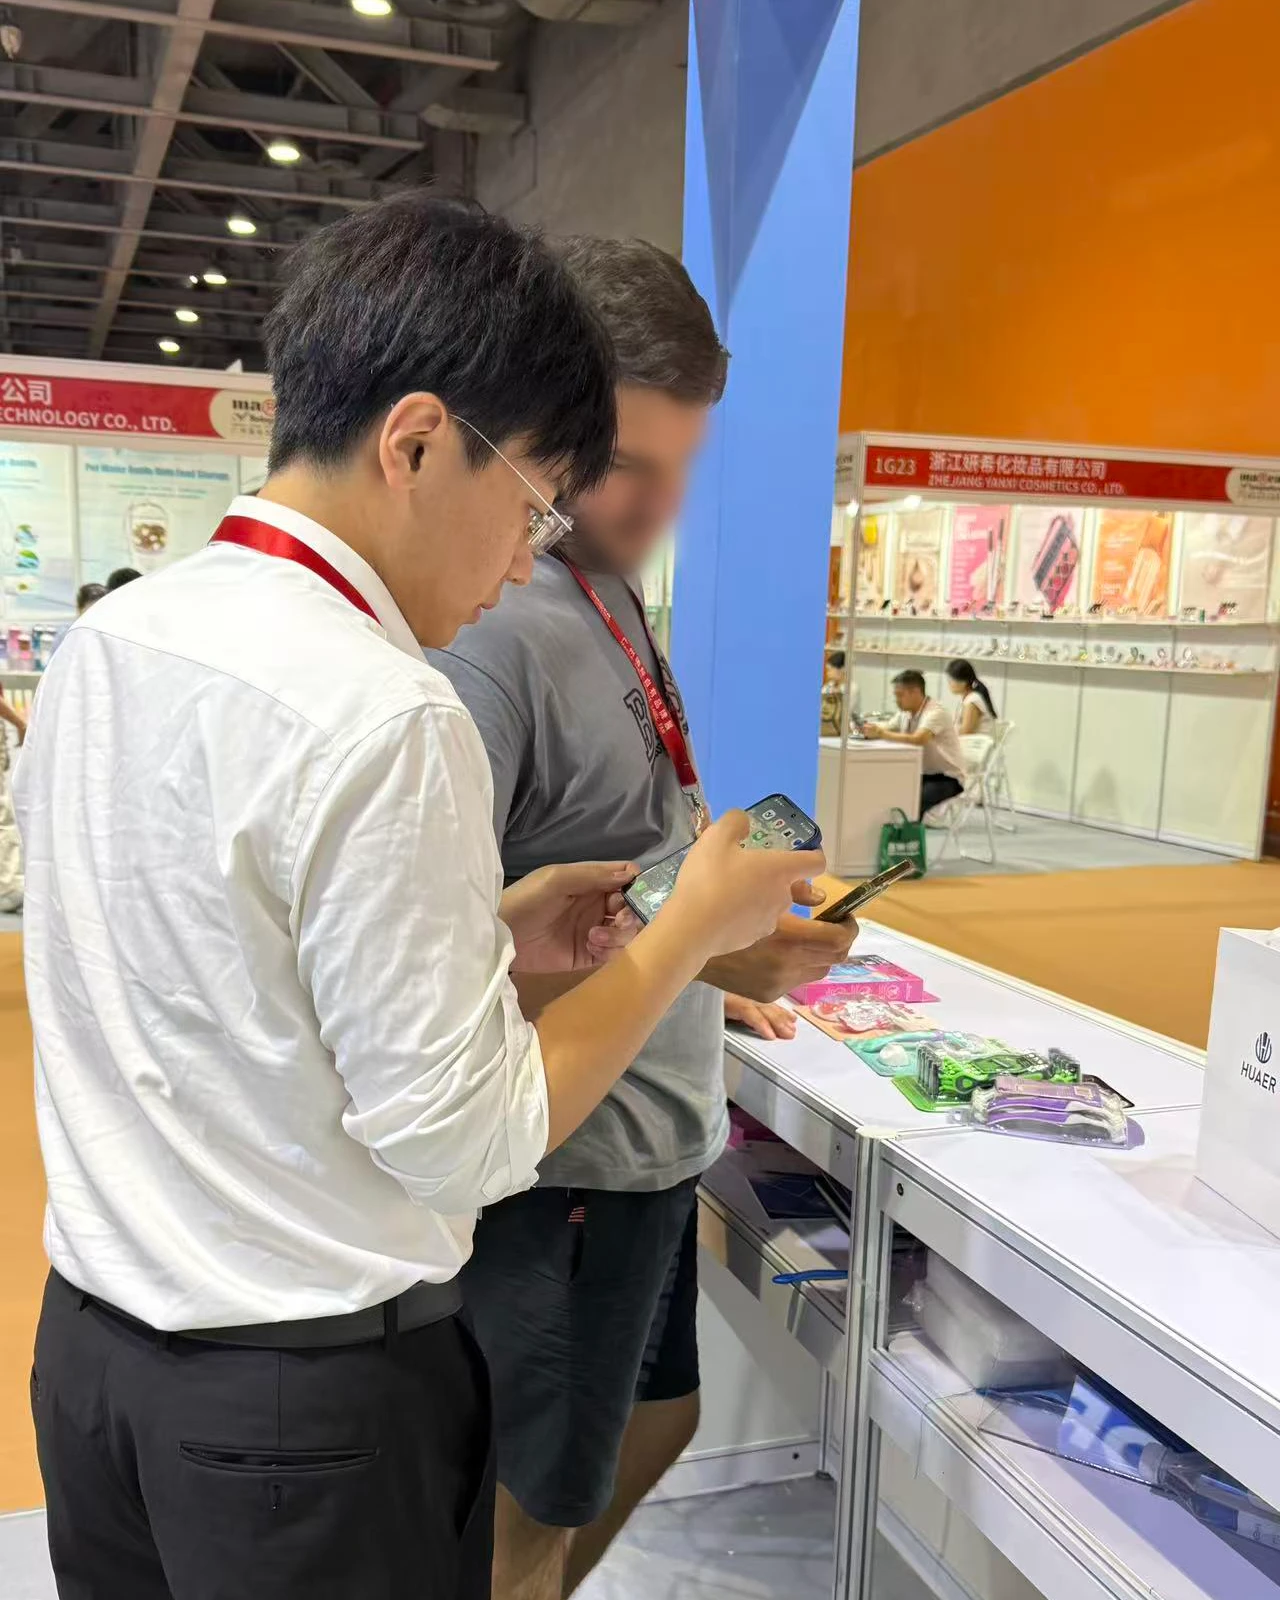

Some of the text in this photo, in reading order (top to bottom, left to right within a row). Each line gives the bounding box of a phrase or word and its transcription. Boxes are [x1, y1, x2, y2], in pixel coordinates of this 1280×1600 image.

[1, 377, 52, 406] 公司
[103, 413, 138, 431] CO.,
[142, 415, 177, 432] LTD.
[874, 456, 917, 476] 1G23
[1240, 1061, 1277, 1094] HUAER
